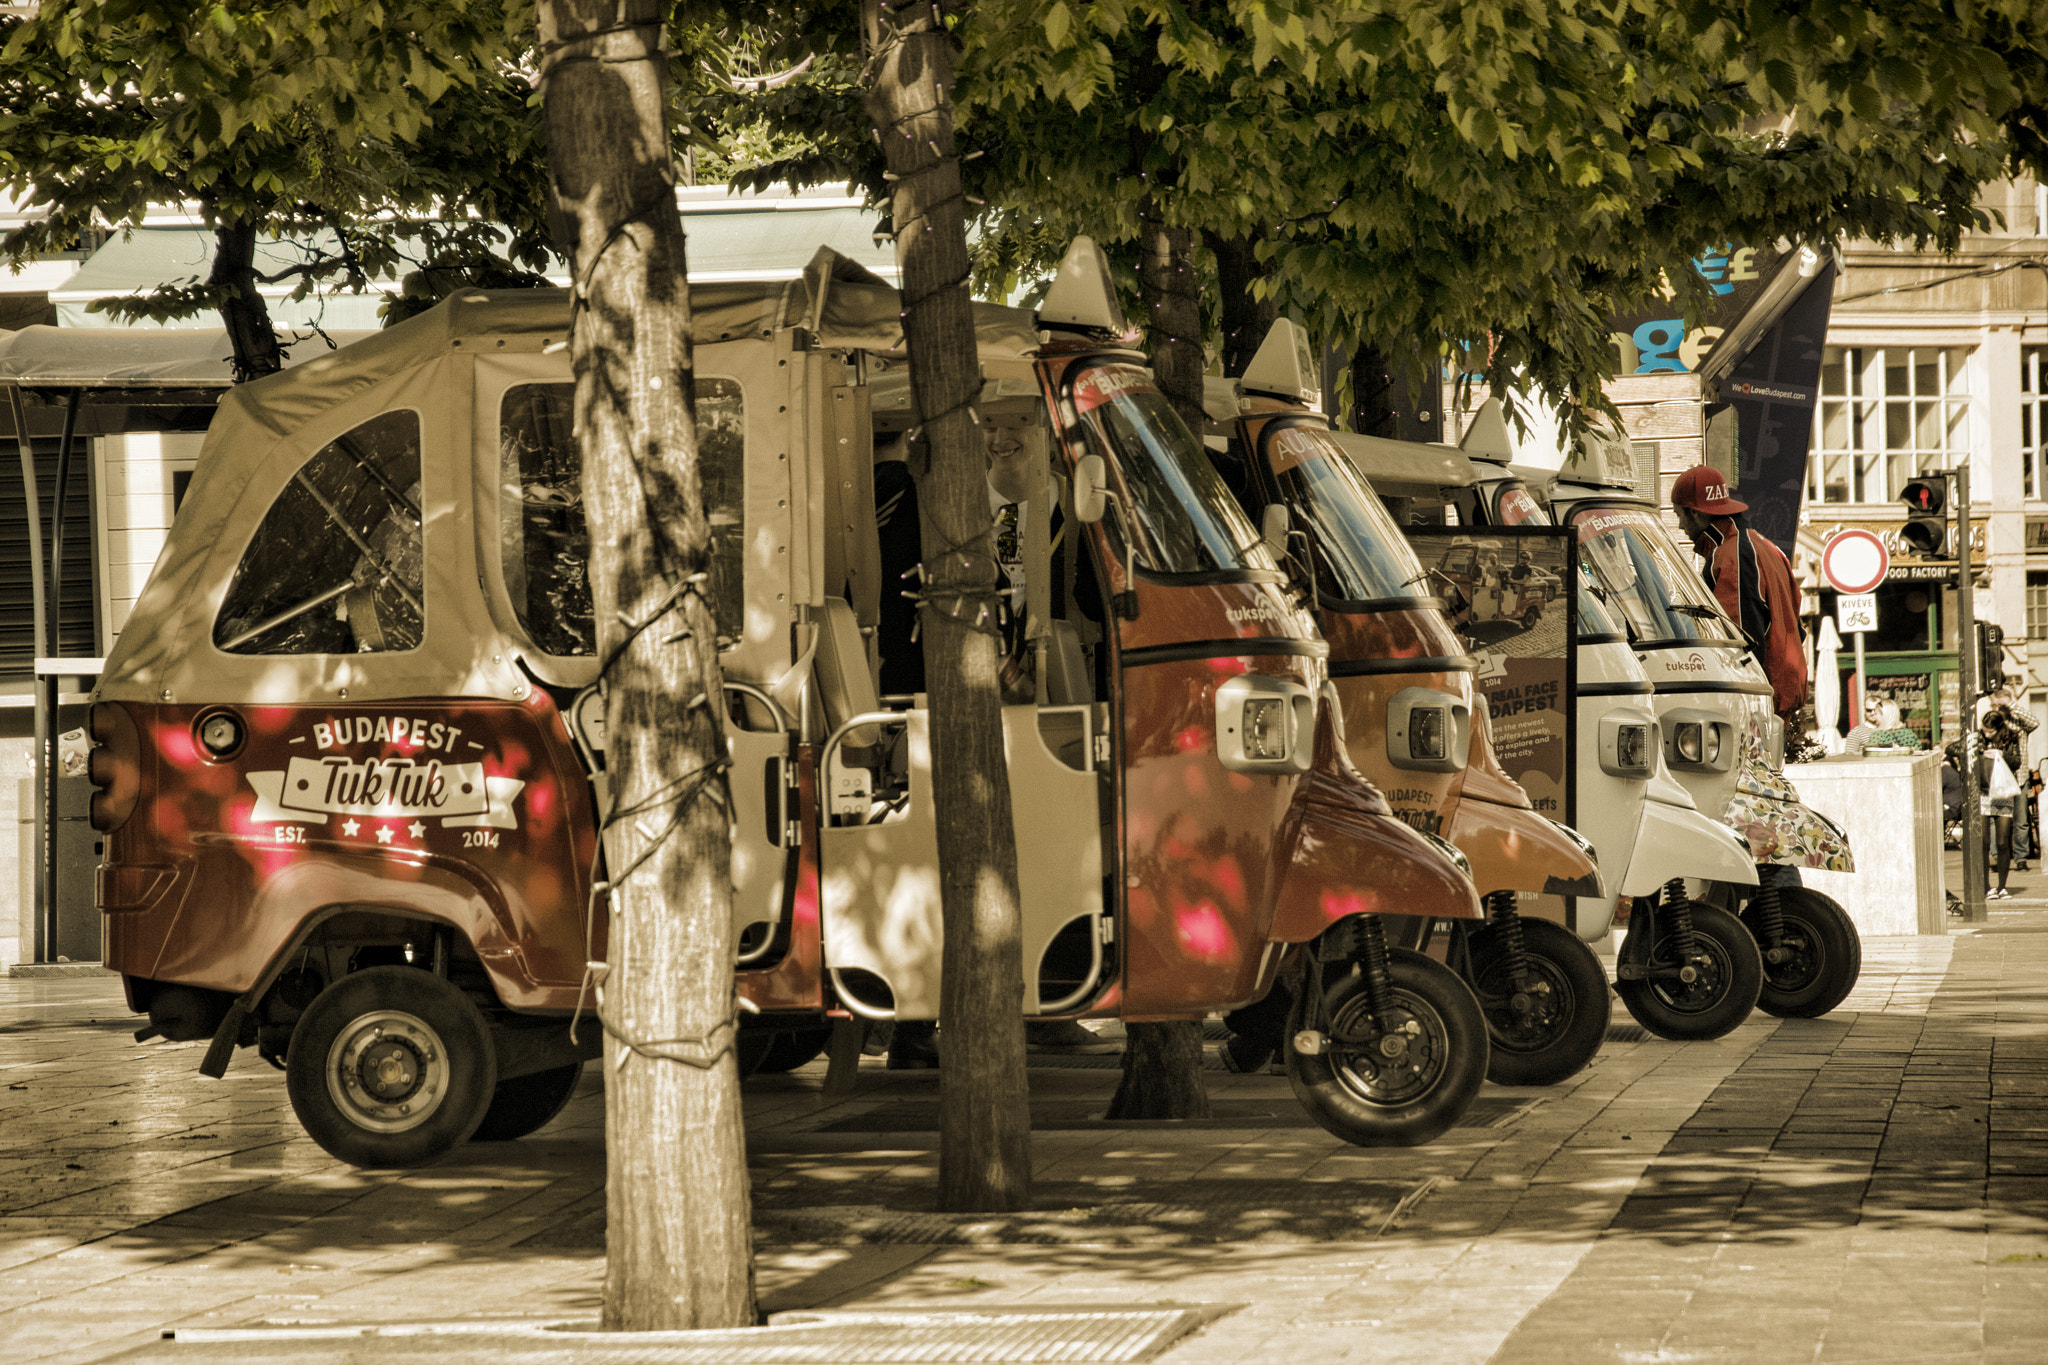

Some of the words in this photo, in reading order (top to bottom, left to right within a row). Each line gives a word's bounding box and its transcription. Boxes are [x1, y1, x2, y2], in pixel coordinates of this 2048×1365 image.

[1911, 566, 1947, 578] FACTORY
[1841, 597, 1873, 609] KIVÉVE
[1665, 661, 1707, 673] tukspot
[1484, 677, 1501, 688] 2014
[1491, 687, 1522, 703] REAL
[1525, 680, 1558, 697] FACE
[1489, 693, 1558, 720] DAPEST
[1518, 717, 1545, 729] newest
[312, 716, 462, 753] BUDAPEST
[1499, 732, 1521, 742] offers
[1496, 744, 1504, 752] to
[1505, 739, 1534, 750] explore
[1534, 735, 1550, 744] and
[1504, 751, 1517, 759] the
[274, 826, 307, 845] EST.
[461, 831, 501, 849] 2014
[1517, 890, 1539, 901] WISH
